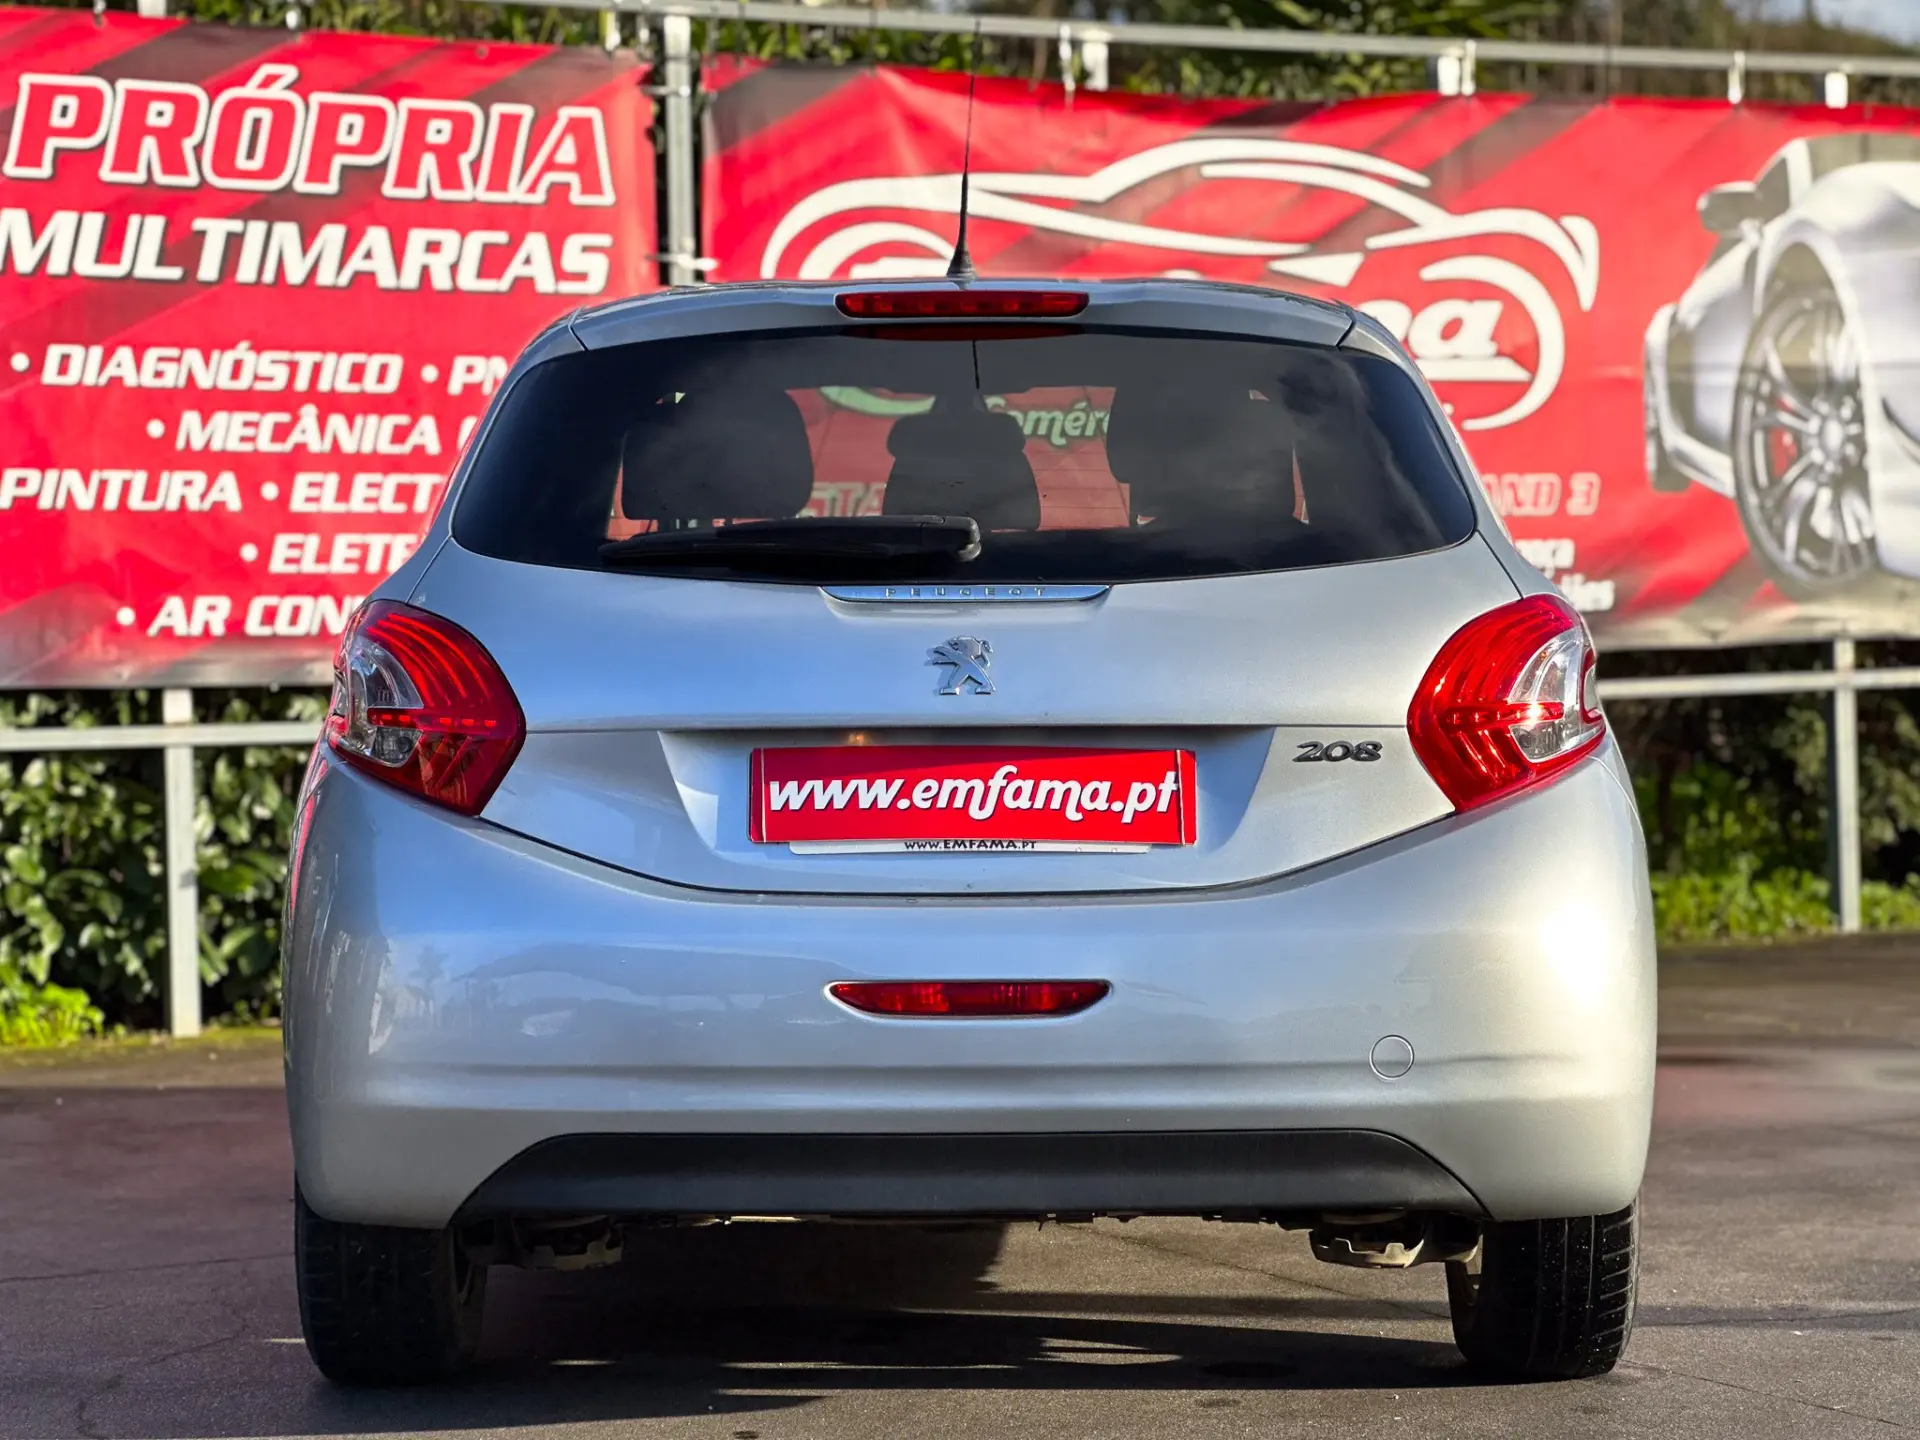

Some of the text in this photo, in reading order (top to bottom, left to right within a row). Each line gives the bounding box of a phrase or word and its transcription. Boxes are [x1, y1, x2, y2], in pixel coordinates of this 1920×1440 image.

[3, 64, 616, 206] PRÓPRIA
[0, 207, 613, 294] MULTIMARCAS
[41, 341, 404, 395] DIAGNÓSTICO
[175, 403, 442, 455] MECÂNICA
[0, 467, 243, 512] PINTURA
[146, 594, 366, 638] AR CON
[885, 586, 1045, 599] PEUGEOT
[1291, 740, 1384, 763] 208
[769, 765, 1180, 824] www.emfama.pt
